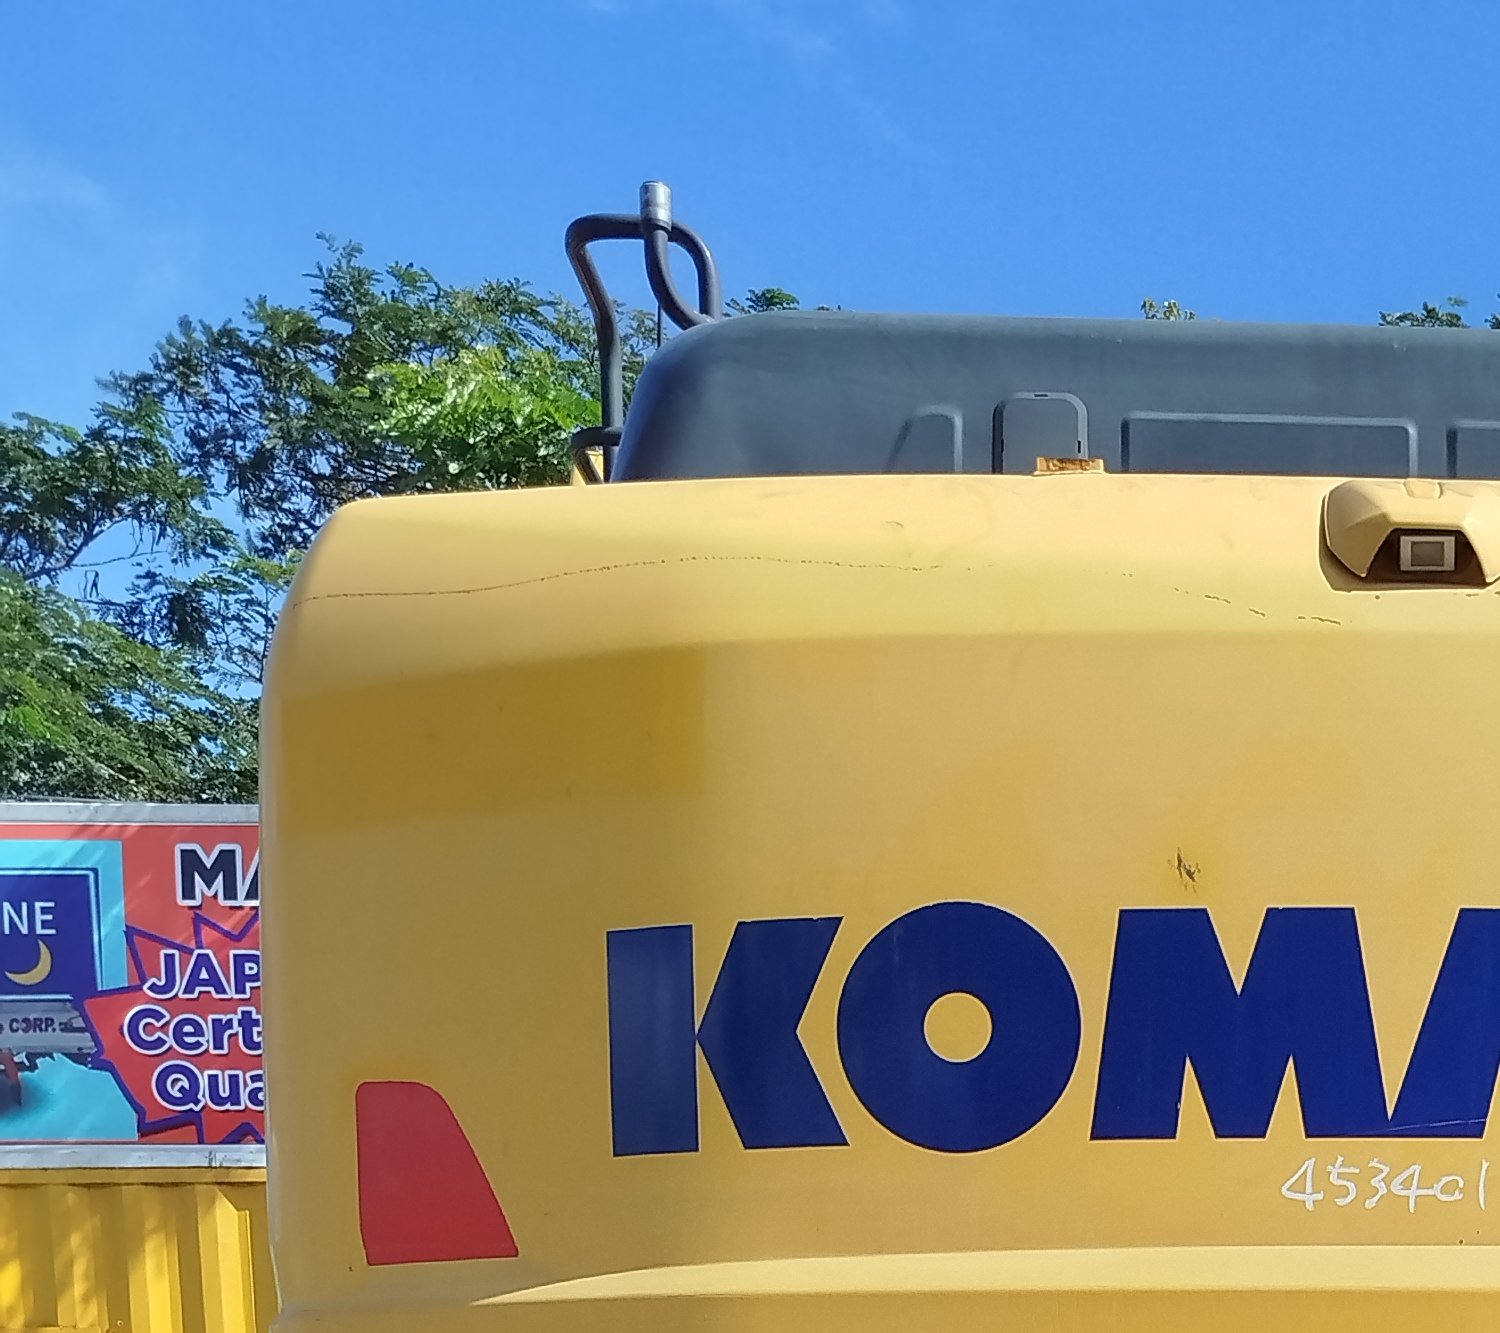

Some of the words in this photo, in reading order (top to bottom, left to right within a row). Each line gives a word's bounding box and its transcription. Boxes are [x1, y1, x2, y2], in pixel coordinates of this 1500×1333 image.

[143, 949, 261, 999] JAP
[9, 1017, 57, 1034] CORP.
[123, 1004, 263, 1055] Cert
